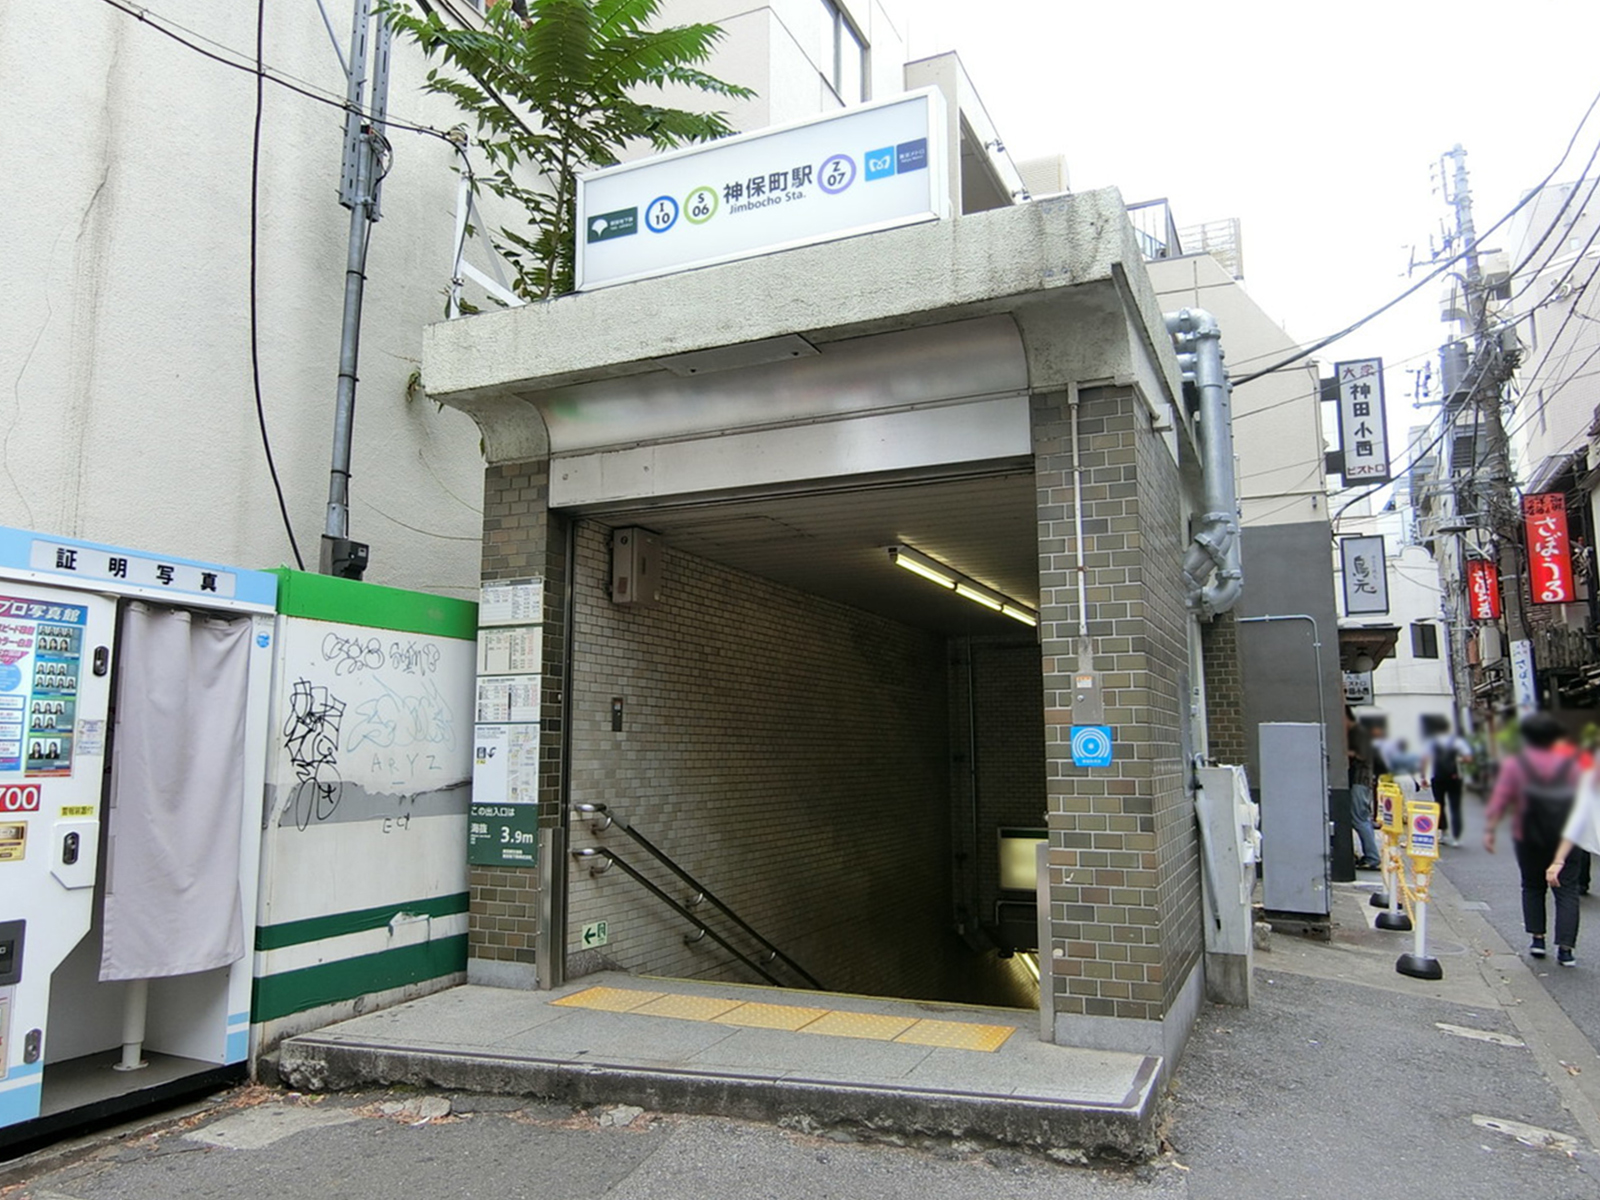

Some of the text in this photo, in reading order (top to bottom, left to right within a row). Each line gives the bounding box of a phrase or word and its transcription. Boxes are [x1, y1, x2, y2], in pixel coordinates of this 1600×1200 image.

[832, 161, 841, 172] Z
[722, 164, 813, 204] 神保町駅
[827, 172, 846, 187] 07
[697, 193, 705, 203] S
[729, 191, 806, 215] Jimbocho Sta.
[659, 202, 665, 213] I
[692, 204, 710, 217] 06
[654, 212, 671, 226] 10
[1350, 382, 1373, 457] 神田小西
[1347, 464, 1385, 476] ビストロ
[1534, 516, 1565, 602] さぼうる
[56, 547, 218, 592] 証明写真
[470, 806, 515, 817] この出入口は
[500, 826, 534, 844] 3.9m
